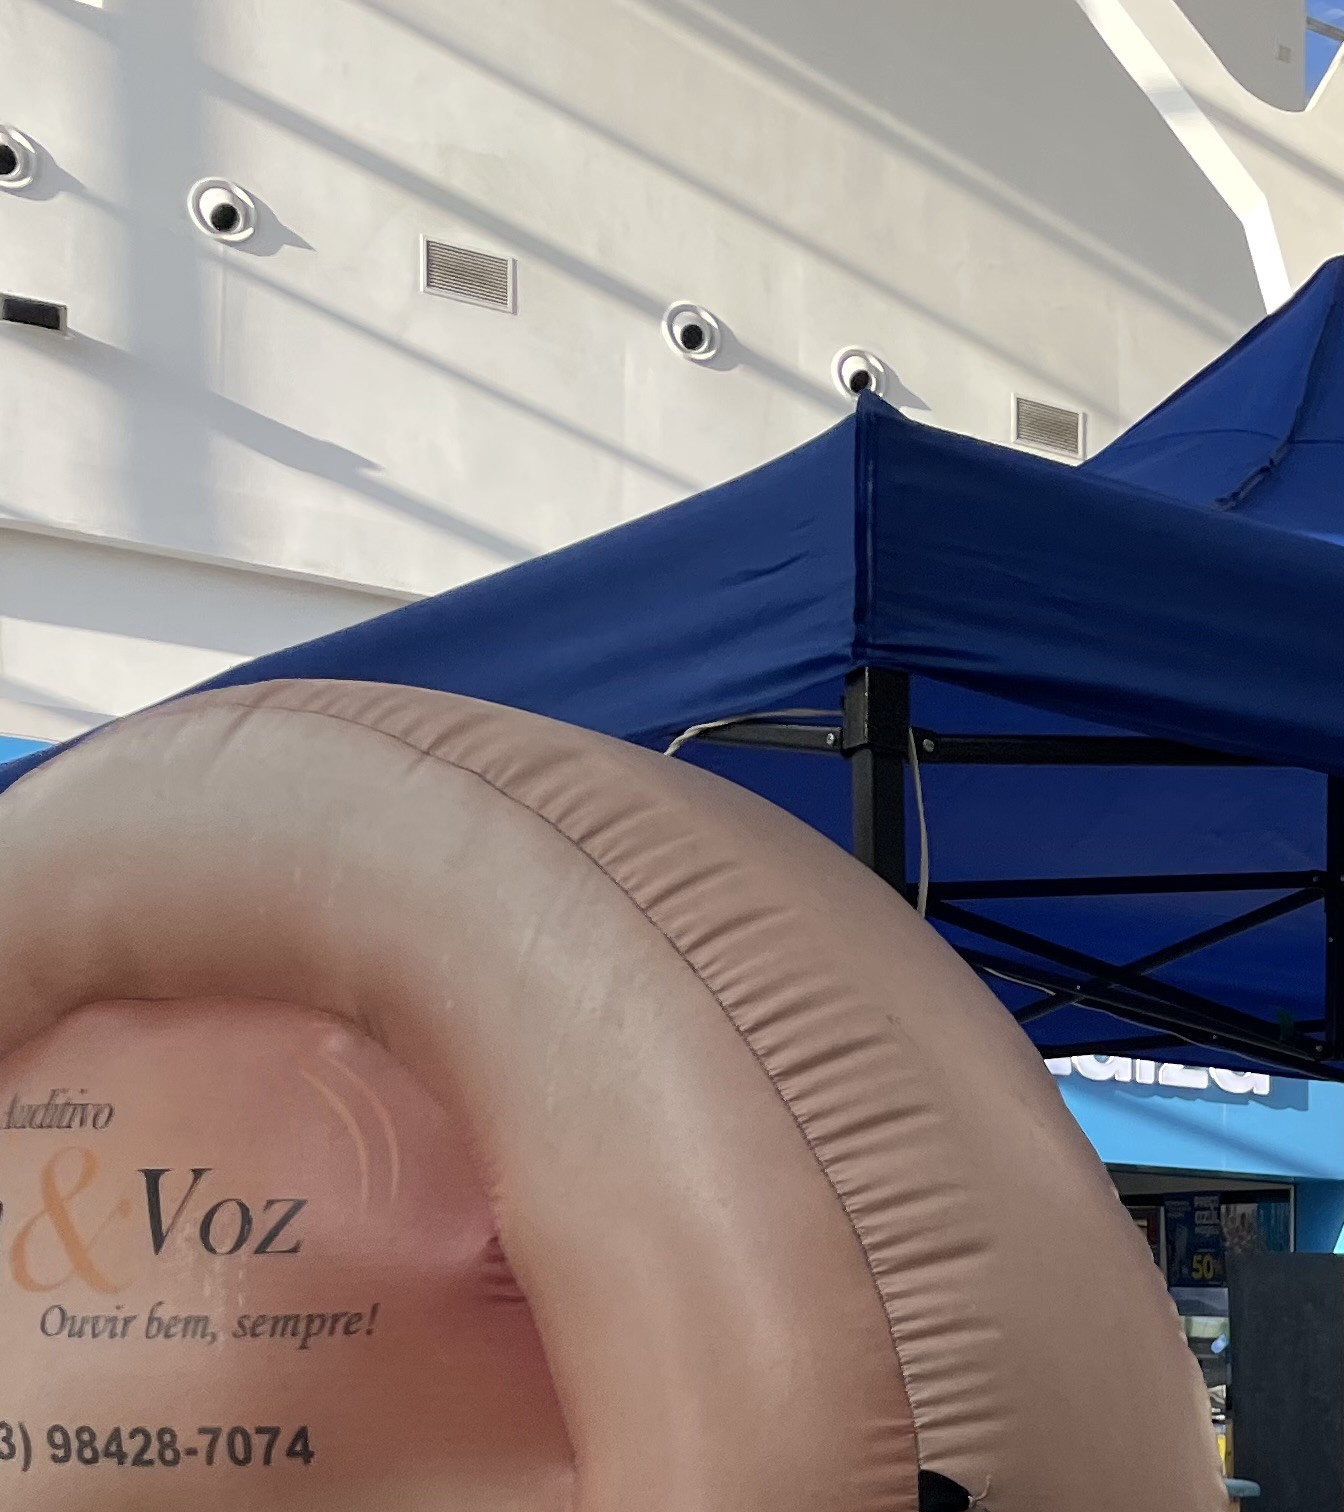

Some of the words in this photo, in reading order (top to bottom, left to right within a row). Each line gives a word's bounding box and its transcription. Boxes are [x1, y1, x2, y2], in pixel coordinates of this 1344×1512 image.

[10, 1146, 133, 1294] &
[136, 1167, 308, 1256] Voz
[41, 1303, 138, 1339] Ouvir
[145, 1301, 217, 1345] bem,
[231, 1302, 382, 1350] sempre!
[46, 1423, 315, 1467] 98428-7074
